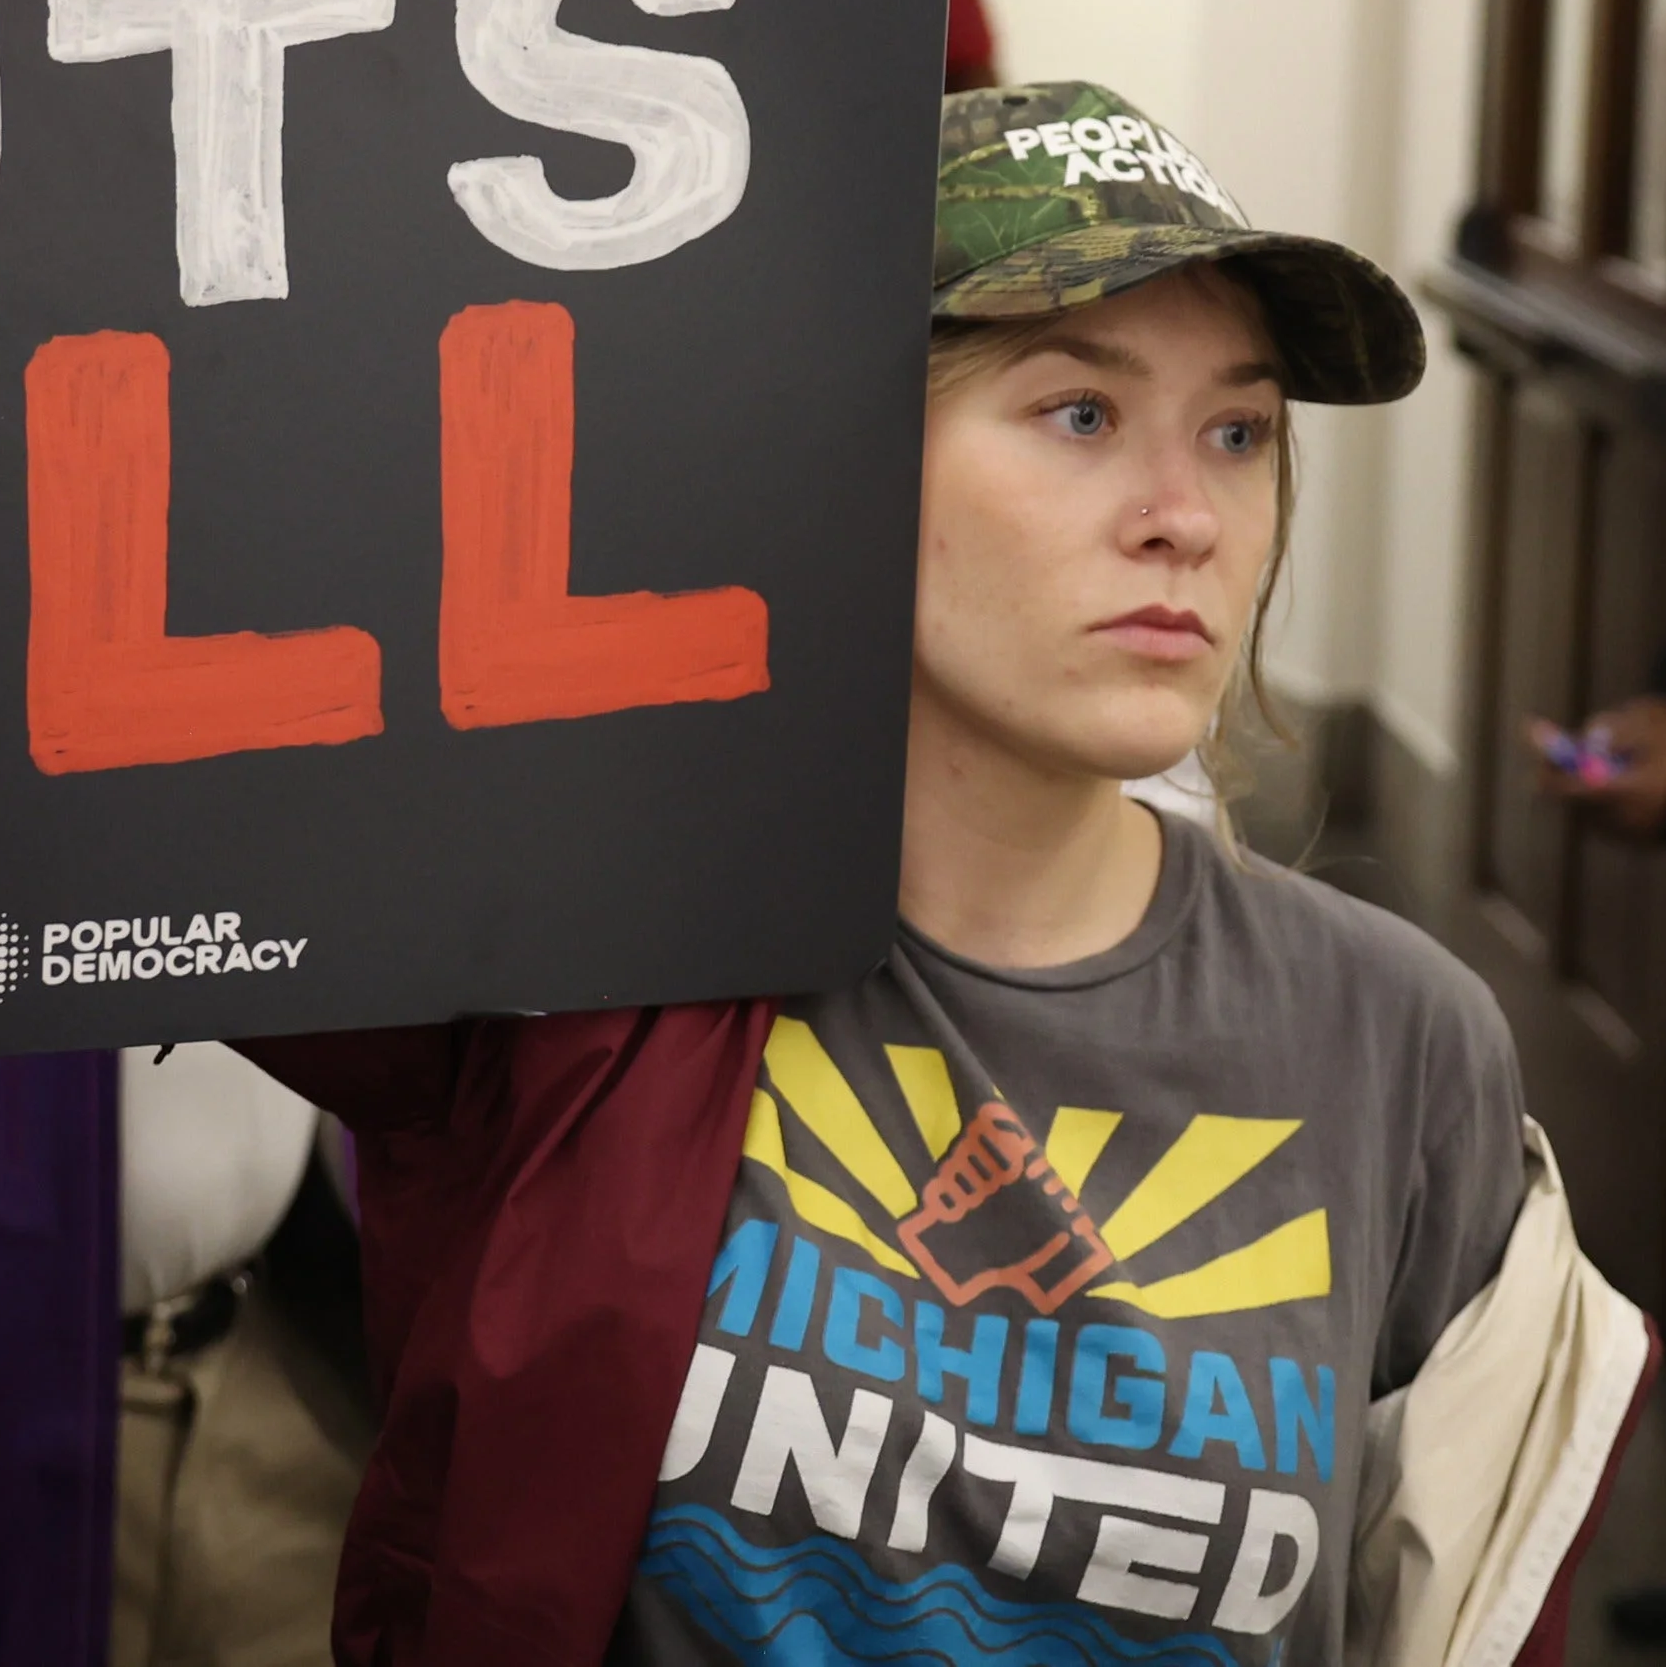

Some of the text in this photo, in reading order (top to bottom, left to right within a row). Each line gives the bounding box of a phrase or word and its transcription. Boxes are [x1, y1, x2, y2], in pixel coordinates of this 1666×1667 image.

[43, 912, 241, 954] POPULAR
[42, 938, 308, 985] DEMOCRACY
[707, 1218, 1336, 1483] MICHIGAN
